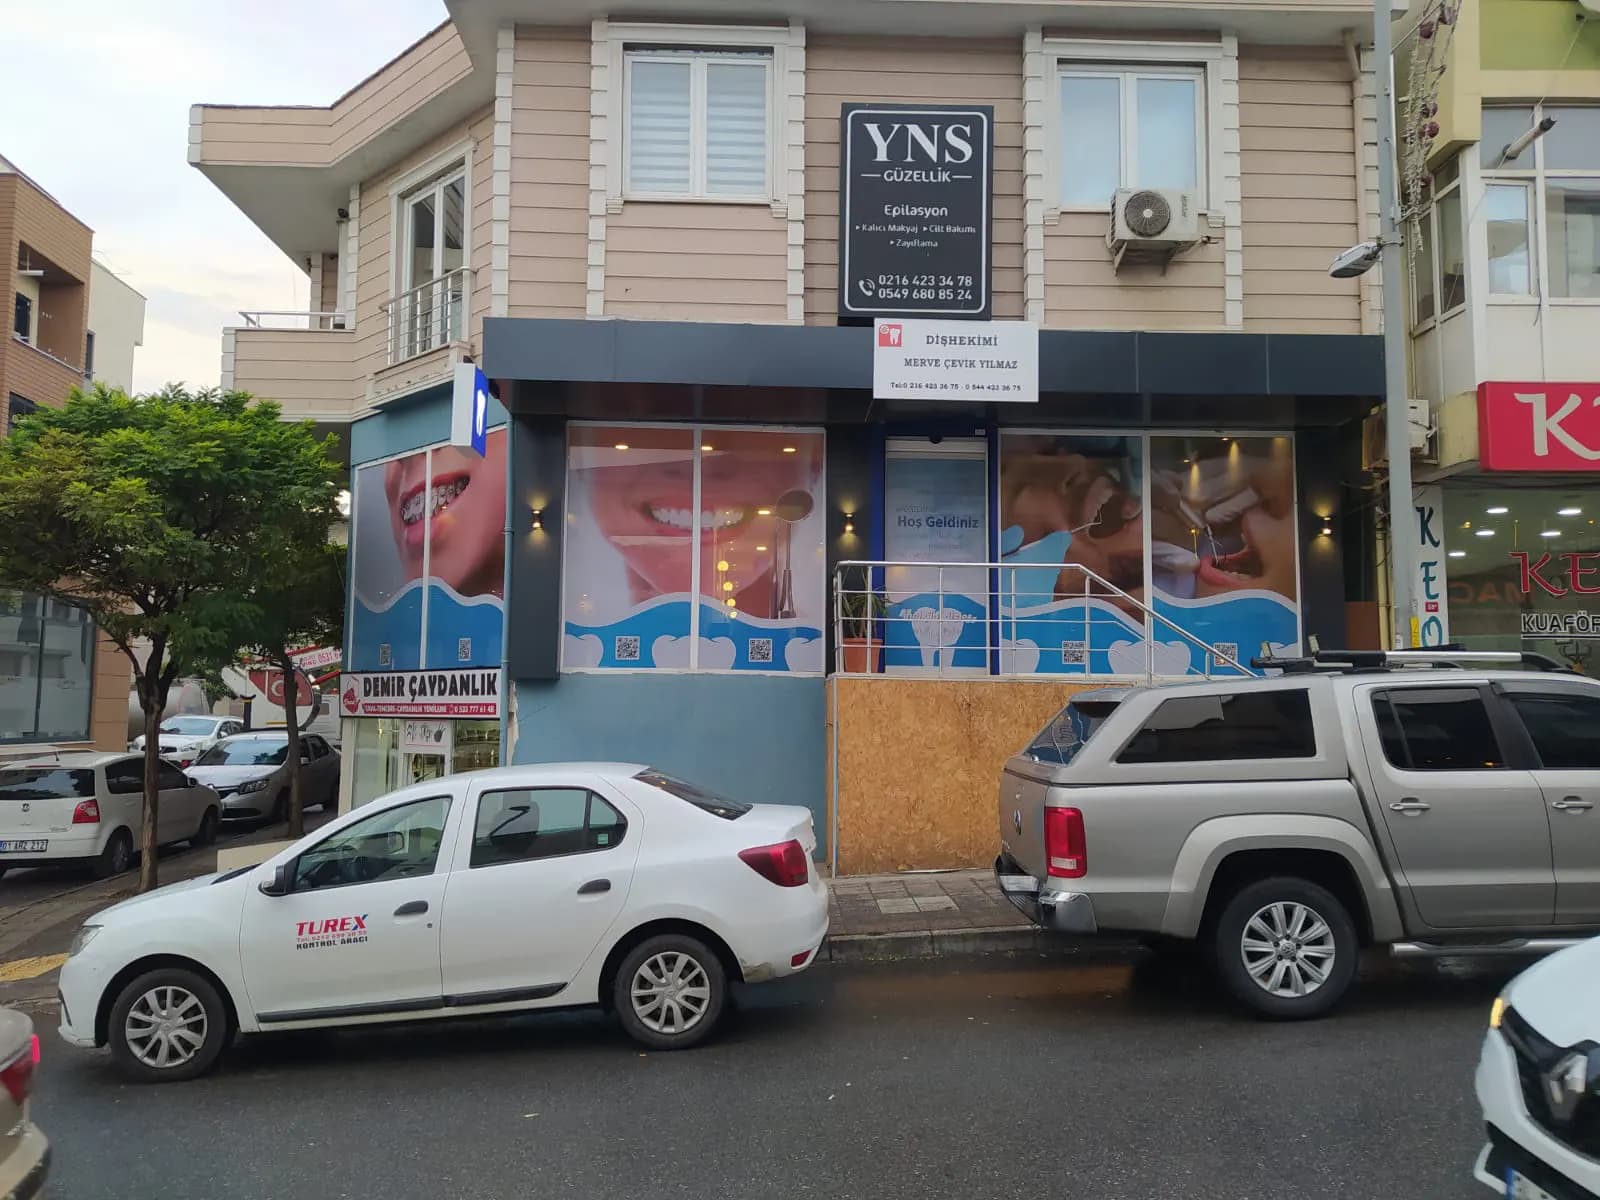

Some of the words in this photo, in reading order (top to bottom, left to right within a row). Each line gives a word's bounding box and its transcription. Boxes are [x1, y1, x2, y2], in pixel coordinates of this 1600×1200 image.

[863, 123, 973, 164] YNS
[883, 167, 952, 183] GÜZELLİK
[884, 204, 949, 219] Epilasyon
[862, 223, 887, 232] Kalıcı
[888, 223, 919, 234] Makyaj
[928, 224, 945, 233] Cilt
[946, 225, 976, 234] Bakımı
[896, 238, 939, 249] Zayıflama
[878, 274, 910, 286] 0216
[912, 275, 936, 287] 423
[938, 275, 954, 287] 34
[957, 275, 973, 287] 78
[878, 288, 910, 299] 0549
[912, 288, 936, 300] 680
[938, 289, 954, 300] 85
[957, 289, 973, 300] 24
[926, 333, 998, 347] DİŞHEKİMİ
[904, 358, 941, 368] MERVE
[979, 359, 1018, 370] YILMAZ
[1513, 392, 1600, 461] K
[897, 515, 922, 529] Hoş
[926, 515, 980, 529] Geldiniz
[363, 675, 405, 698] DEMİR
[408, 672, 498, 702] ÇAYDANLIK
[296, 914, 368, 937] TUREX
[296, 940, 338, 950] KONTROL
[340, 936, 368, 945] ARACI
